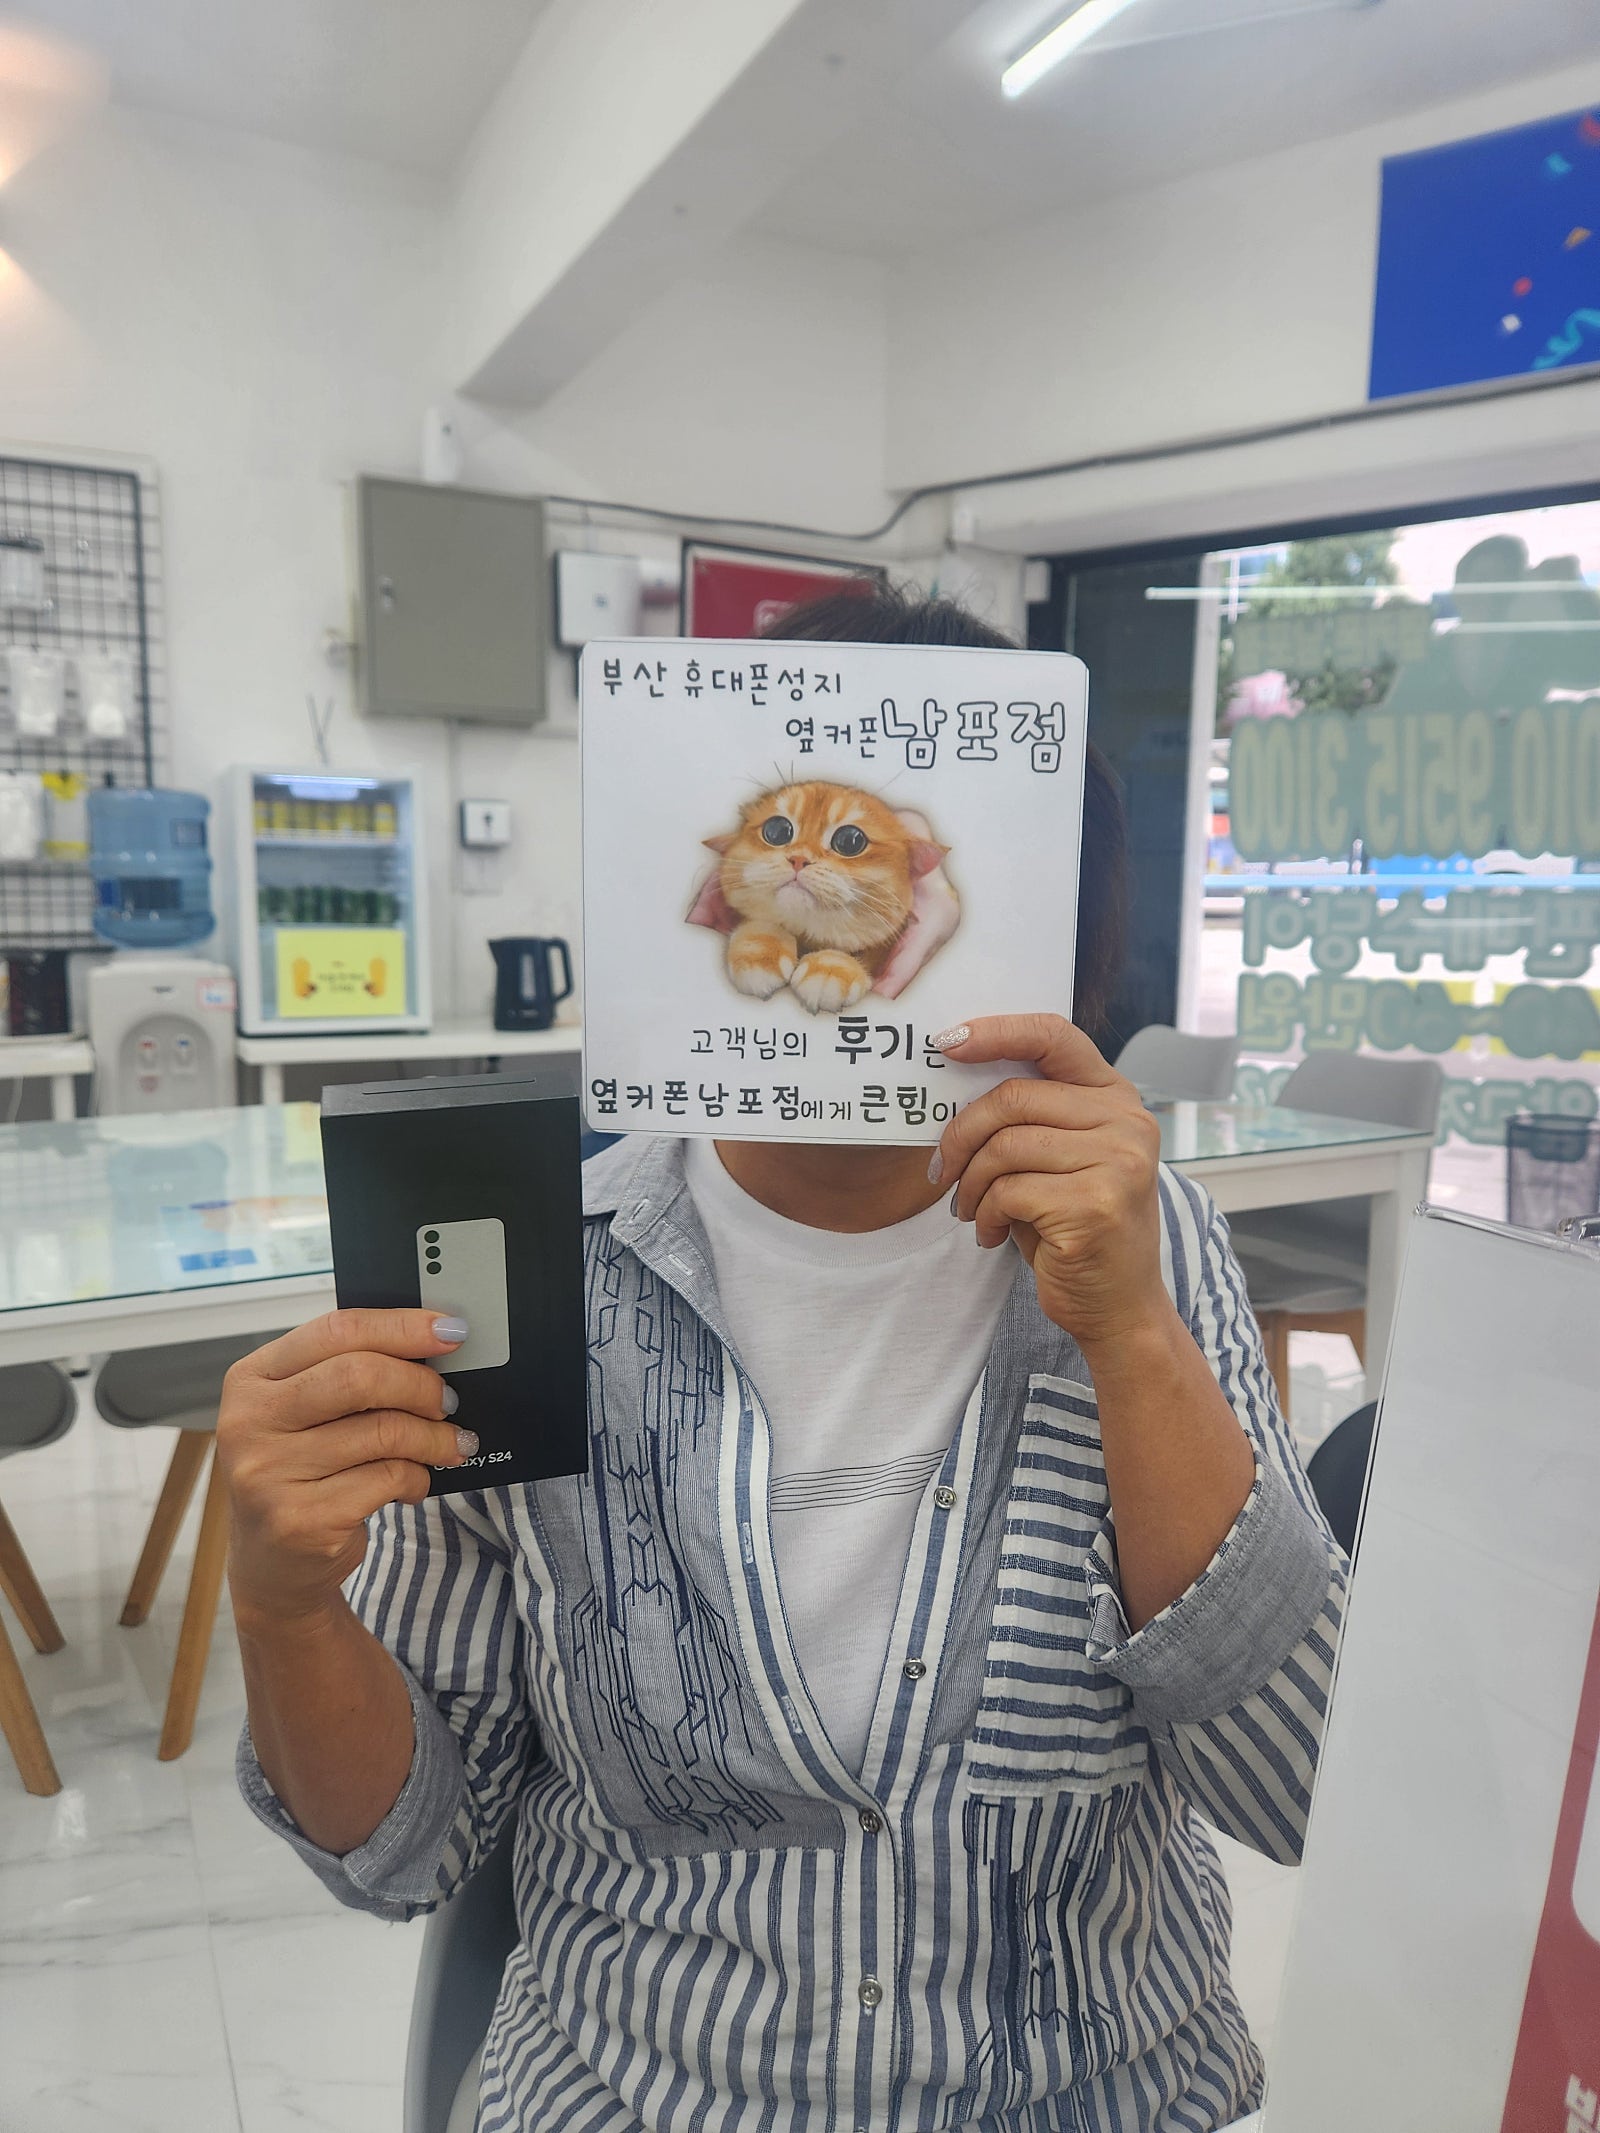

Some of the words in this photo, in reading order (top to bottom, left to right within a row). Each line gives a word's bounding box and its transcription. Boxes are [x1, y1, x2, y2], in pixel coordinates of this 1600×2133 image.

[602, 658, 667, 698] 부산
[690, 1026, 808, 1060] 고객님의
[488, 1450, 513, 1464] S24
